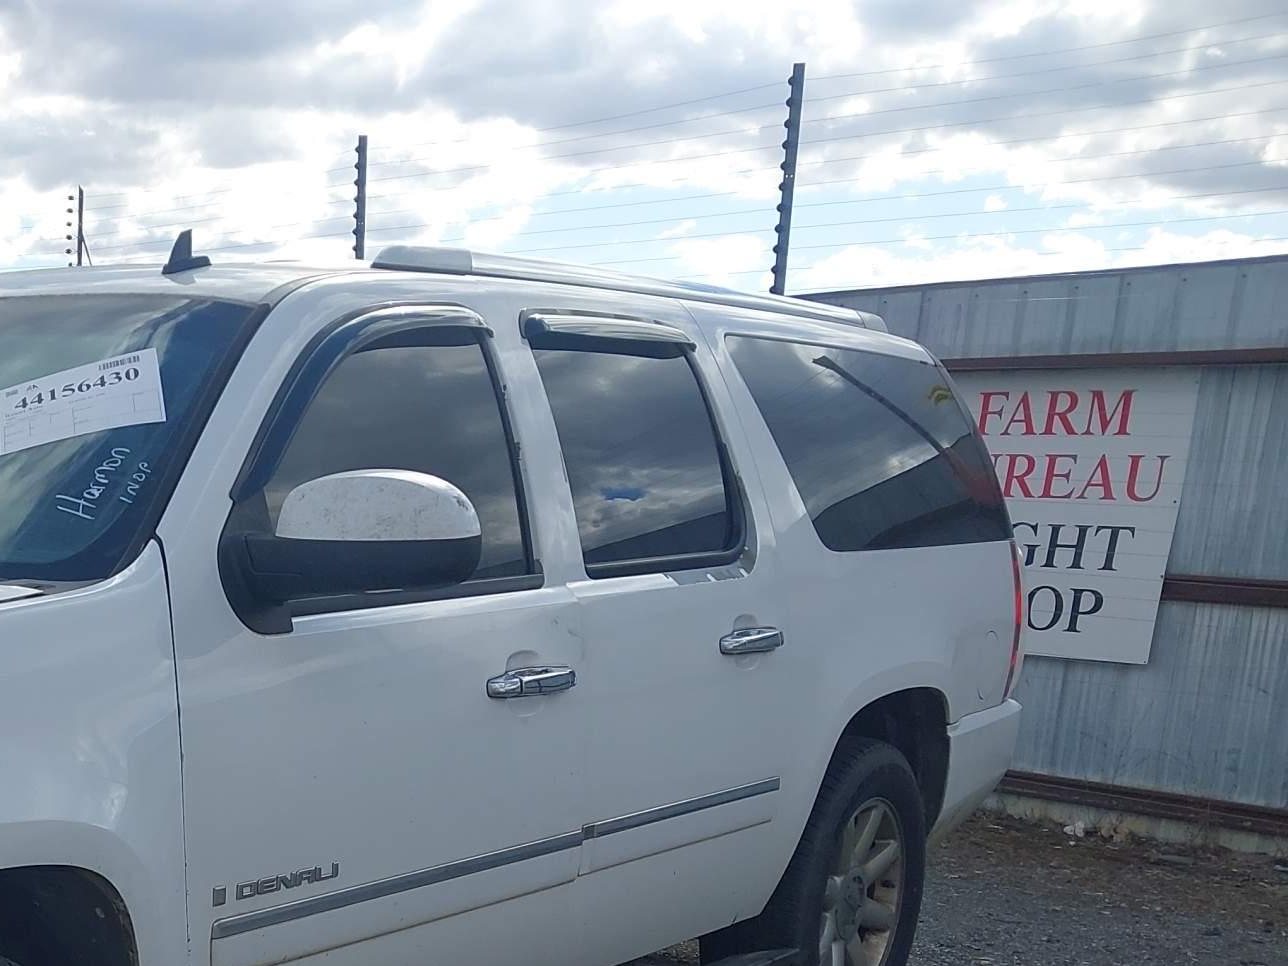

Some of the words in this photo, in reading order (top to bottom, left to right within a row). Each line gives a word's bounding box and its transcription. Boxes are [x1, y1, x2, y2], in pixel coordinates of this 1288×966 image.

[14, 367, 140, 410] 44156430
[978, 389, 1138, 436] FARM
[991, 453, 1171, 502] REAU
[1012, 521, 1137, 572] GHT
[235, 862, 340, 901] DENALI
